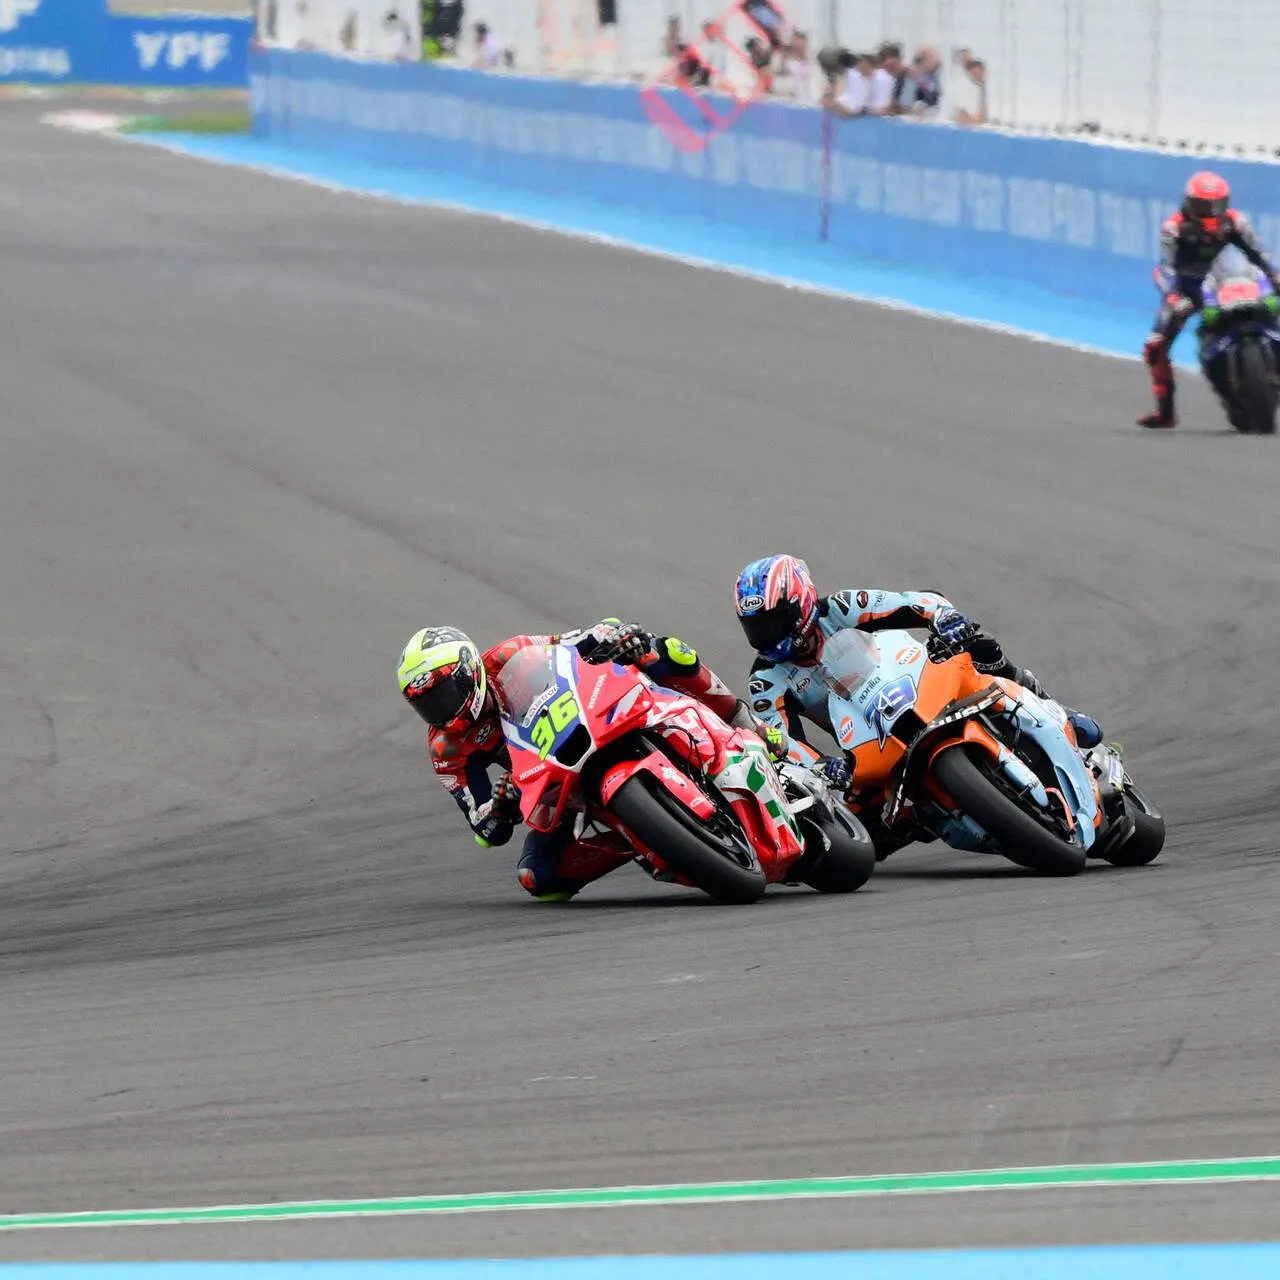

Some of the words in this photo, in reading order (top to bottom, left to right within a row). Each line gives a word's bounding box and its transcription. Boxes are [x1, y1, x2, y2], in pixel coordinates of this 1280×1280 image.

[133, 30, 230, 71] YPF
[742, 597, 763, 610] Arai
[587, 673, 608, 710] HONDA
[858, 675, 882, 704] aprilia
[531, 689, 580, 762] 36
[520, 762, 547, 781] HONDA
